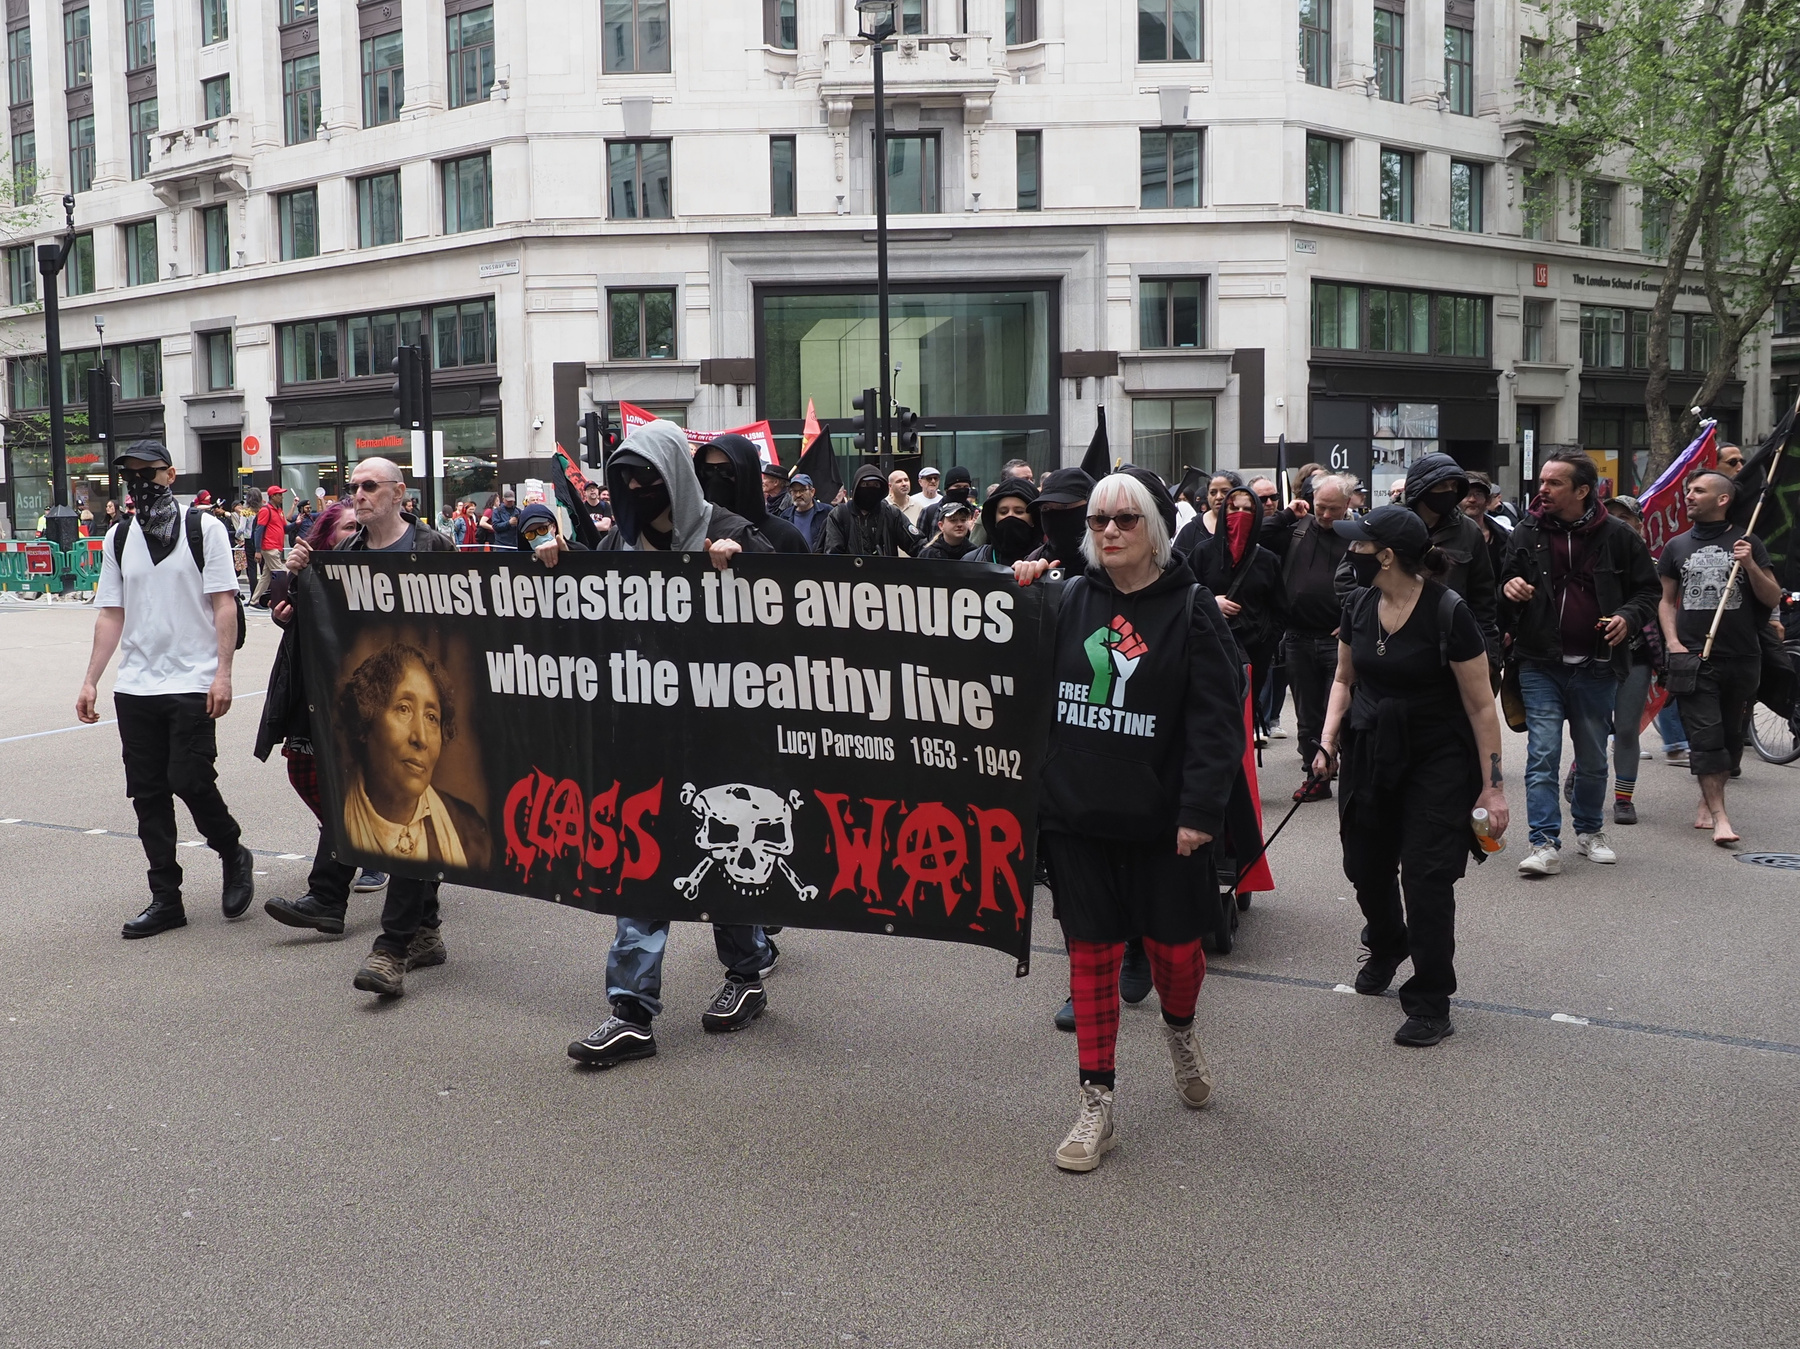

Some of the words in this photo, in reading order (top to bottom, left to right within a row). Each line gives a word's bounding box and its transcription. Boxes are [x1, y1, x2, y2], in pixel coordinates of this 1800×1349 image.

[1537, 267, 1547, 283] LSE
[1573, 273, 1585, 286] The
[1587, 275, 1610, 287] London
[1612, 277, 1633, 290] School
[1634, 279, 1641, 291] of
[212, 410, 216, 419] 2
[355, 435, 404, 449] HermanMiller
[1330, 443, 1350, 470] 61
[16, 490, 42, 509] Asari
[325, 565, 395, 613] "We
[398, 569, 488, 616] must
[490, 566, 693, 623] devastate
[701, 568, 784, 625] the
[794, 578, 1014, 643] avenues
[486, 644, 598, 701] where
[609, 649, 680, 707] the
[688, 656, 891, 721] wealthy
[901, 662, 1014, 730] live"
[1058, 681, 1090, 703] FREE
[1057, 700, 1157, 738] PALESTINE
[777, 724, 816, 760] Lucy
[821, 728, 895, 762] Parsons
[910, 736, 958, 770] 1853
[974, 744, 1023, 780] 1942
[503, 765, 664, 895] CLASS
[814, 789, 1026, 920] WAR
